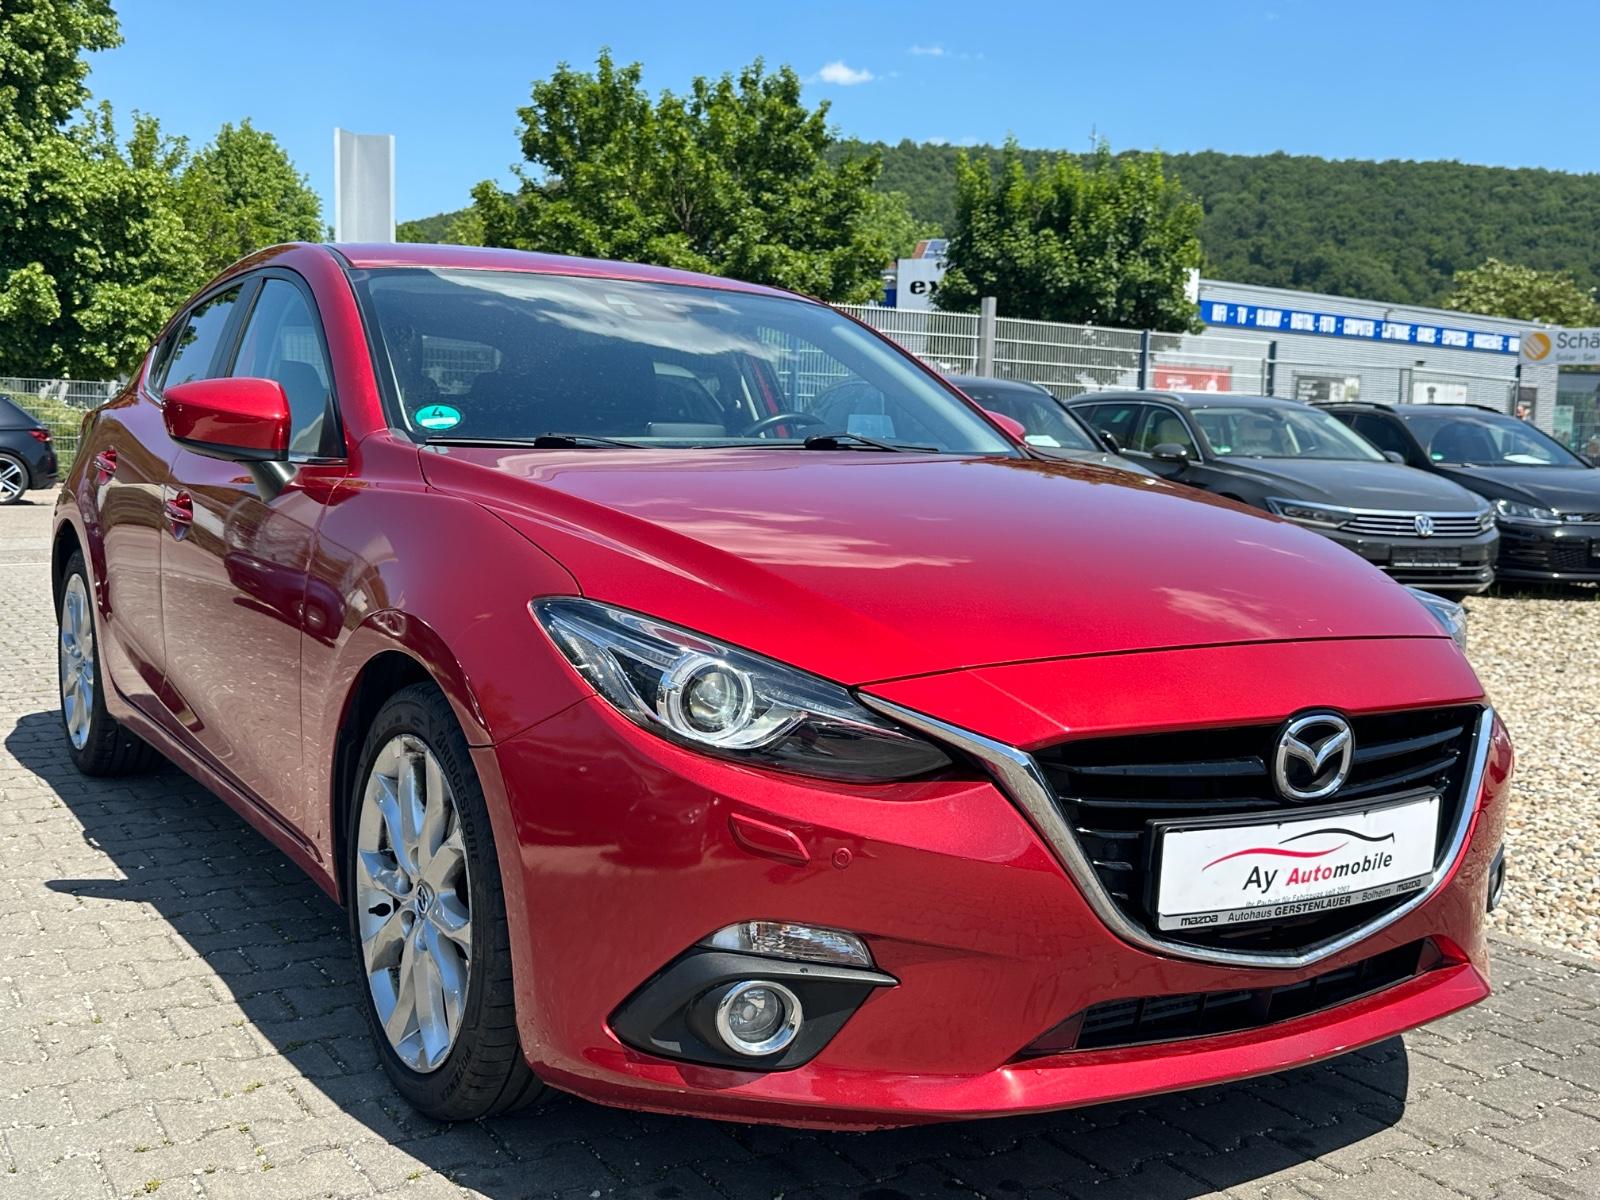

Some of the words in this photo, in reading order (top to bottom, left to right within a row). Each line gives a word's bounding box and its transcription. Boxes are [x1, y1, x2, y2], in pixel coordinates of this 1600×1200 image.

[434, 730, 481, 865] BRIDGESTONE
[1242, 865, 1278, 894] Ay
[1286, 852, 1393, 886] Automobile
[1228, 909, 1272, 922] Autohaus
[1275, 895, 1352, 916] GERSTENLAUER
[1361, 888, 1391, 901] Bolheim
